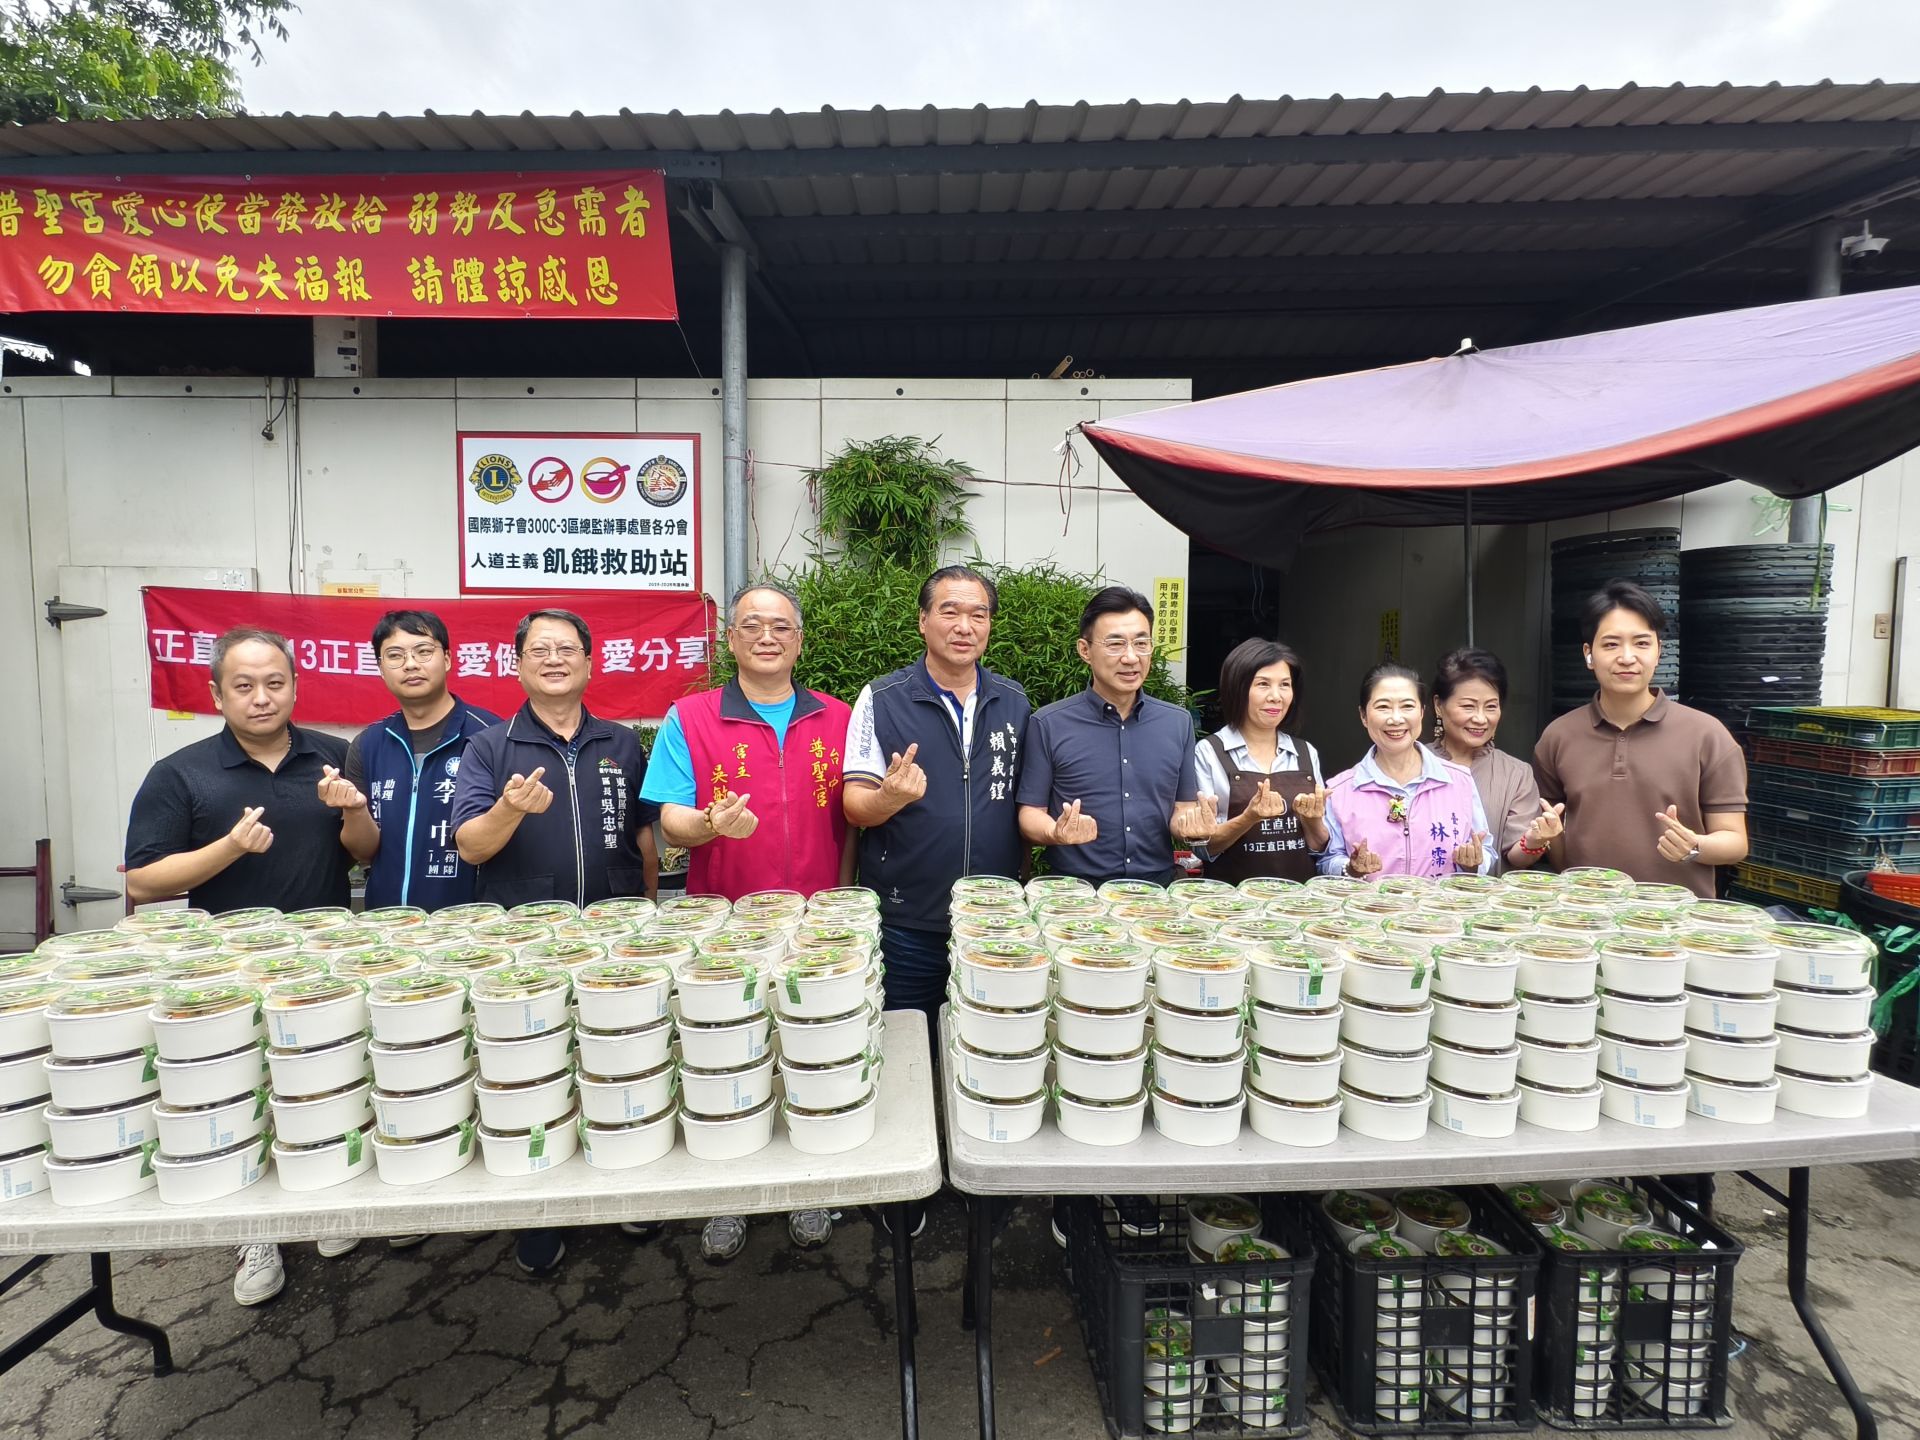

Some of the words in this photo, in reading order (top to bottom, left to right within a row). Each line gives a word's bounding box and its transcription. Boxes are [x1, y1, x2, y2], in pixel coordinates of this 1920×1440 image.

[0, 188, 388, 237] 普聖宮愛心便當發放給
[407, 185, 651, 238] 弱勢及急需者
[37, 251, 372, 303] 勿貪領以免失福報
[406, 254, 619, 306] 請體諒感恩
[480, 455, 511, 466] LIONS
[489, 469, 504, 487] L
[468, 516, 689, 537] 國際獅子會300C-3區總監辦事處暨各分會
[471, 552, 539, 569] 人道主義
[542, 547, 688, 577] 飢餓救助站
[601, 636, 707, 674] 愛分享
[732, 742, 751, 779] 宮主
[809, 736, 829, 808] 普聖宮
[989, 731, 1007, 800] 賴義鍠
[381, 779, 396, 801] 助理
